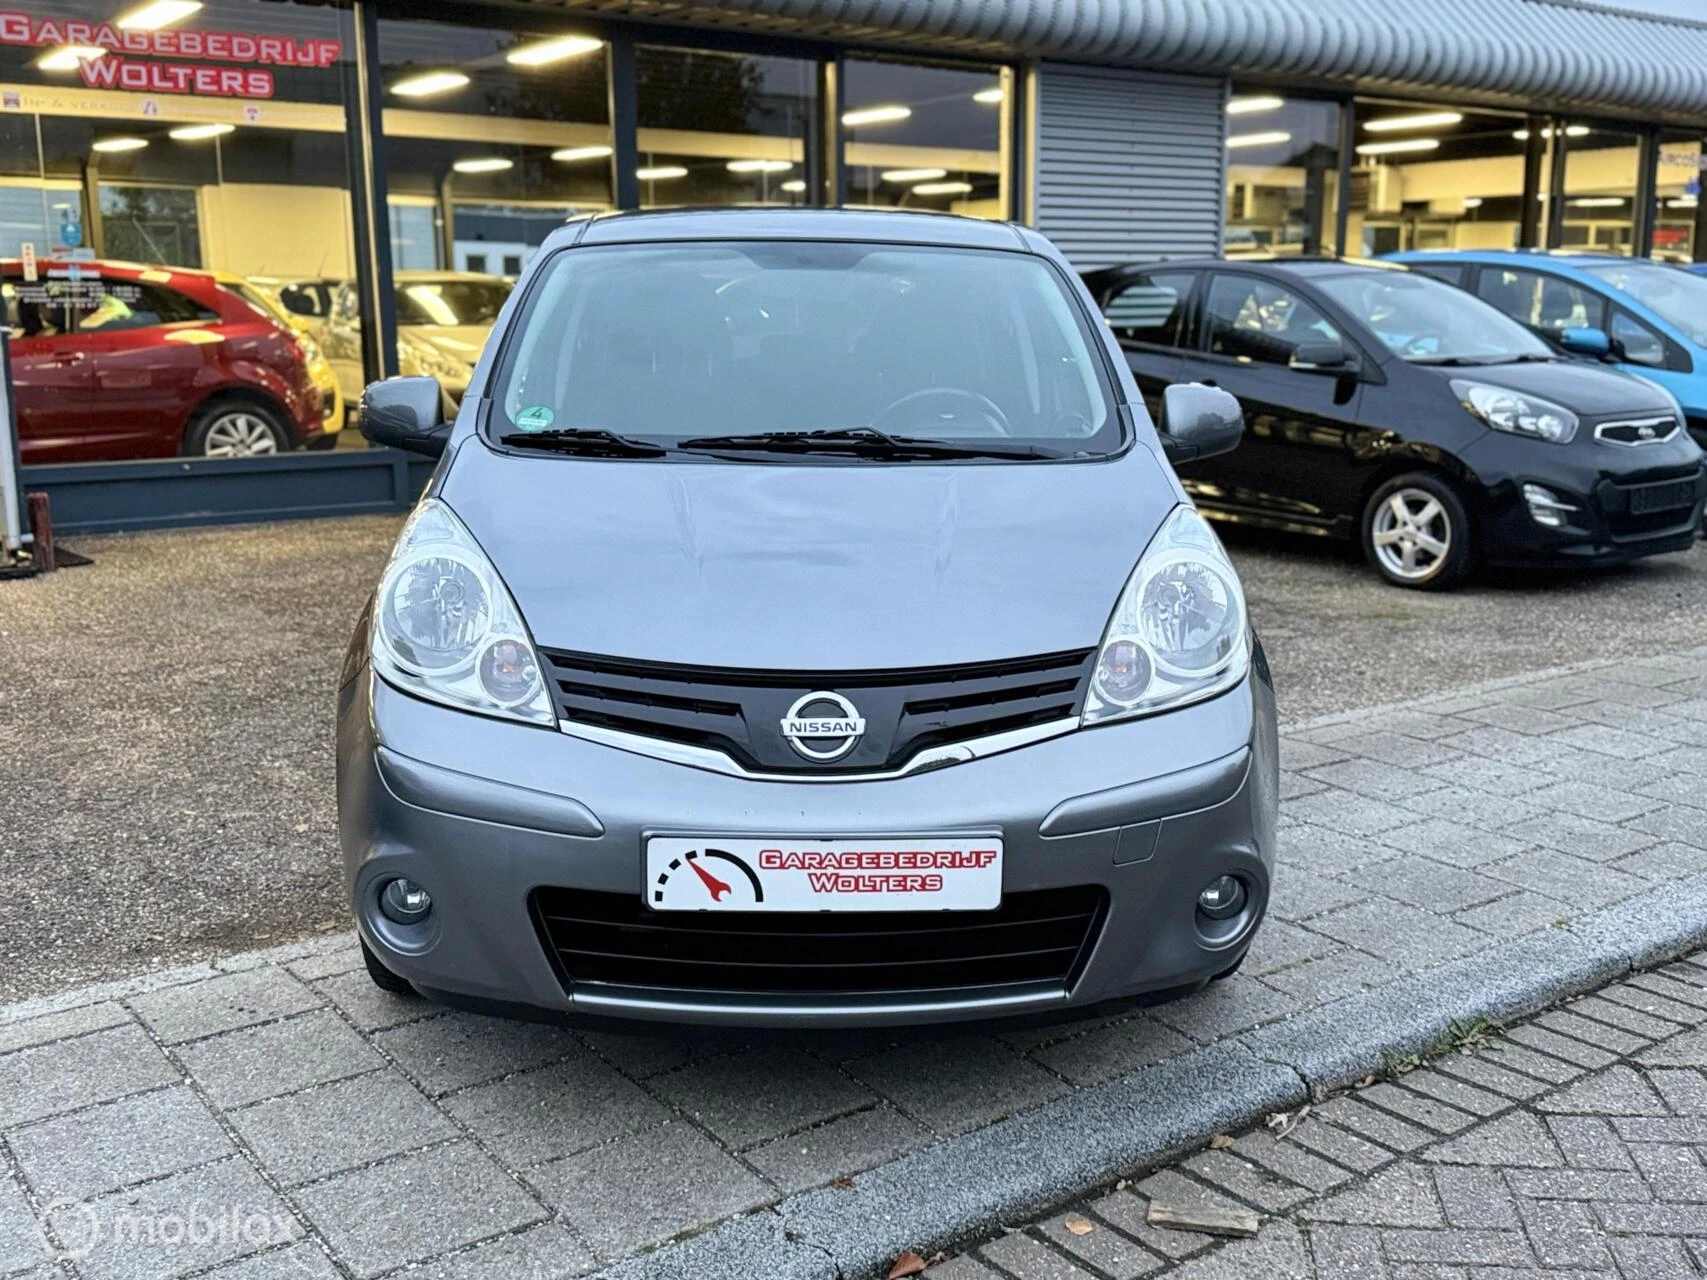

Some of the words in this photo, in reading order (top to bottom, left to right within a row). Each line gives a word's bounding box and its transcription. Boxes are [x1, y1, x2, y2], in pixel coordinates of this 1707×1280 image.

[0, 11, 342, 67] GARAGEBEDRIJF
[79, 56, 274, 97] WOLTERS
[531, 408, 543, 419] 4
[789, 722, 857, 733] NISSAN
[759, 850, 997, 869] GARAGEBEDRIJF
[807, 873, 943, 893] WOLTERS
